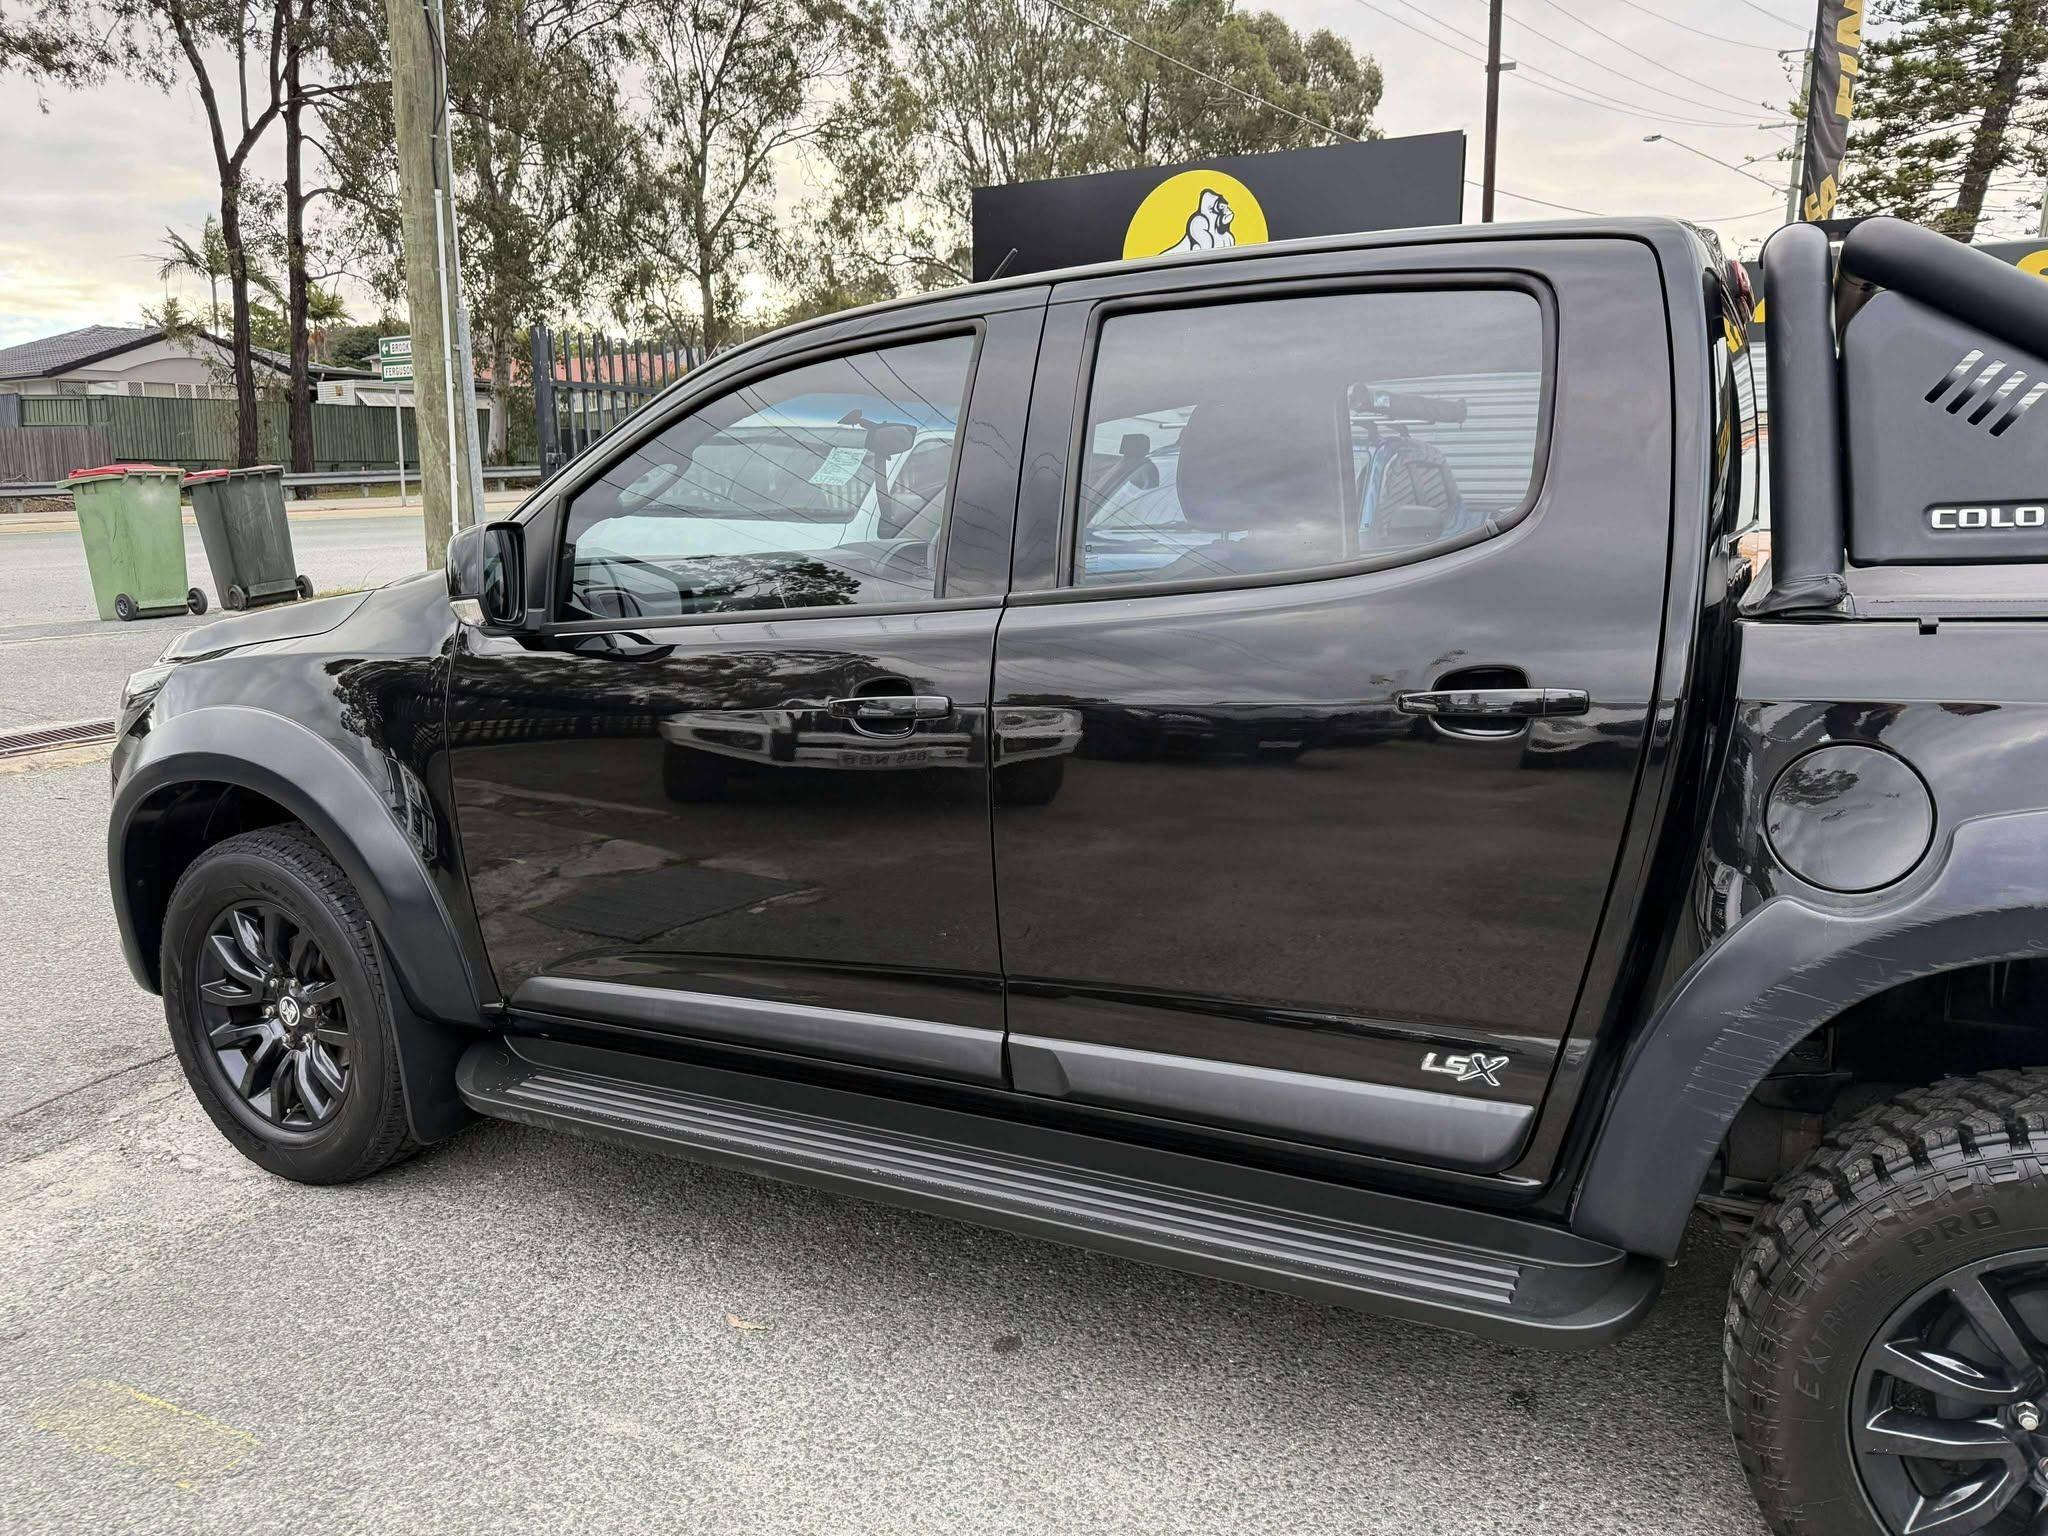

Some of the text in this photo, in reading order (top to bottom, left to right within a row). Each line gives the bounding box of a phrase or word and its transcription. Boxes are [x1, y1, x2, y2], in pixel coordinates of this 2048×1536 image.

[1931, 506, 2045, 529] COLO
[1421, 1052, 1510, 1087] LSX
[1792, 1204, 2001, 1400] EXTREME PRO
